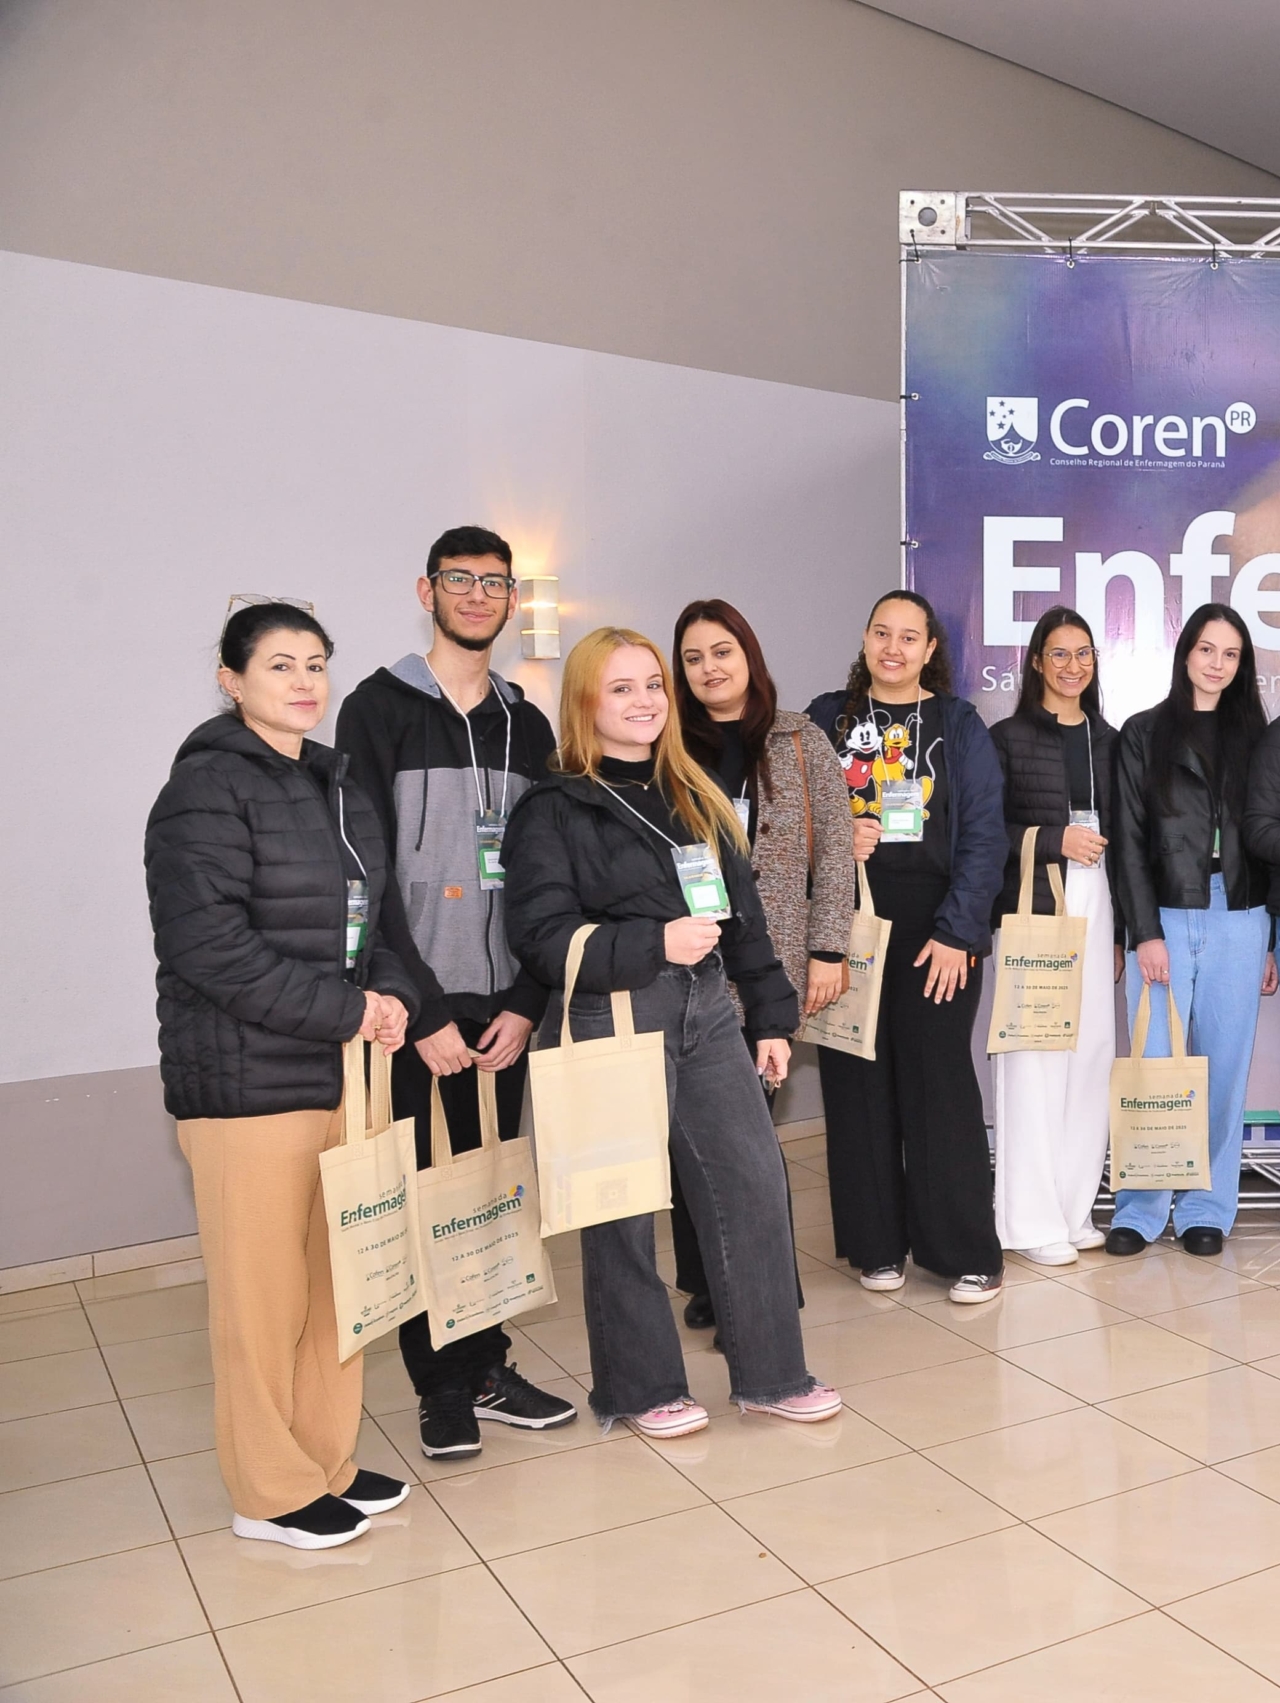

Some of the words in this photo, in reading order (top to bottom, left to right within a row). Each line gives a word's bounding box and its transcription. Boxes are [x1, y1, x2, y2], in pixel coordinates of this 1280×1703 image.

[1050, 398, 1226, 457] Coren
[1230, 410, 1251, 427] PR
[1050, 458, 1087, 467] Conselho
[1088, 459, 1123, 468] Regional
[1135, 459, 1185, 469] Enfermagem
[1186, 460, 1197, 468] do
[1198, 460, 1226, 469] Paraná
[1005, 955, 1073, 971] Enfermagem
[1120, 1097, 1192, 1111] Enfermagem
[472, 1197, 497, 1213] semana
[497, 1193, 507, 1201] da
[432, 1197, 522, 1239] Enfermagem
[475, 1247, 483, 1255] DE
[496, 1236, 503, 1244] DE
[504, 1231, 519, 1240] 2025
